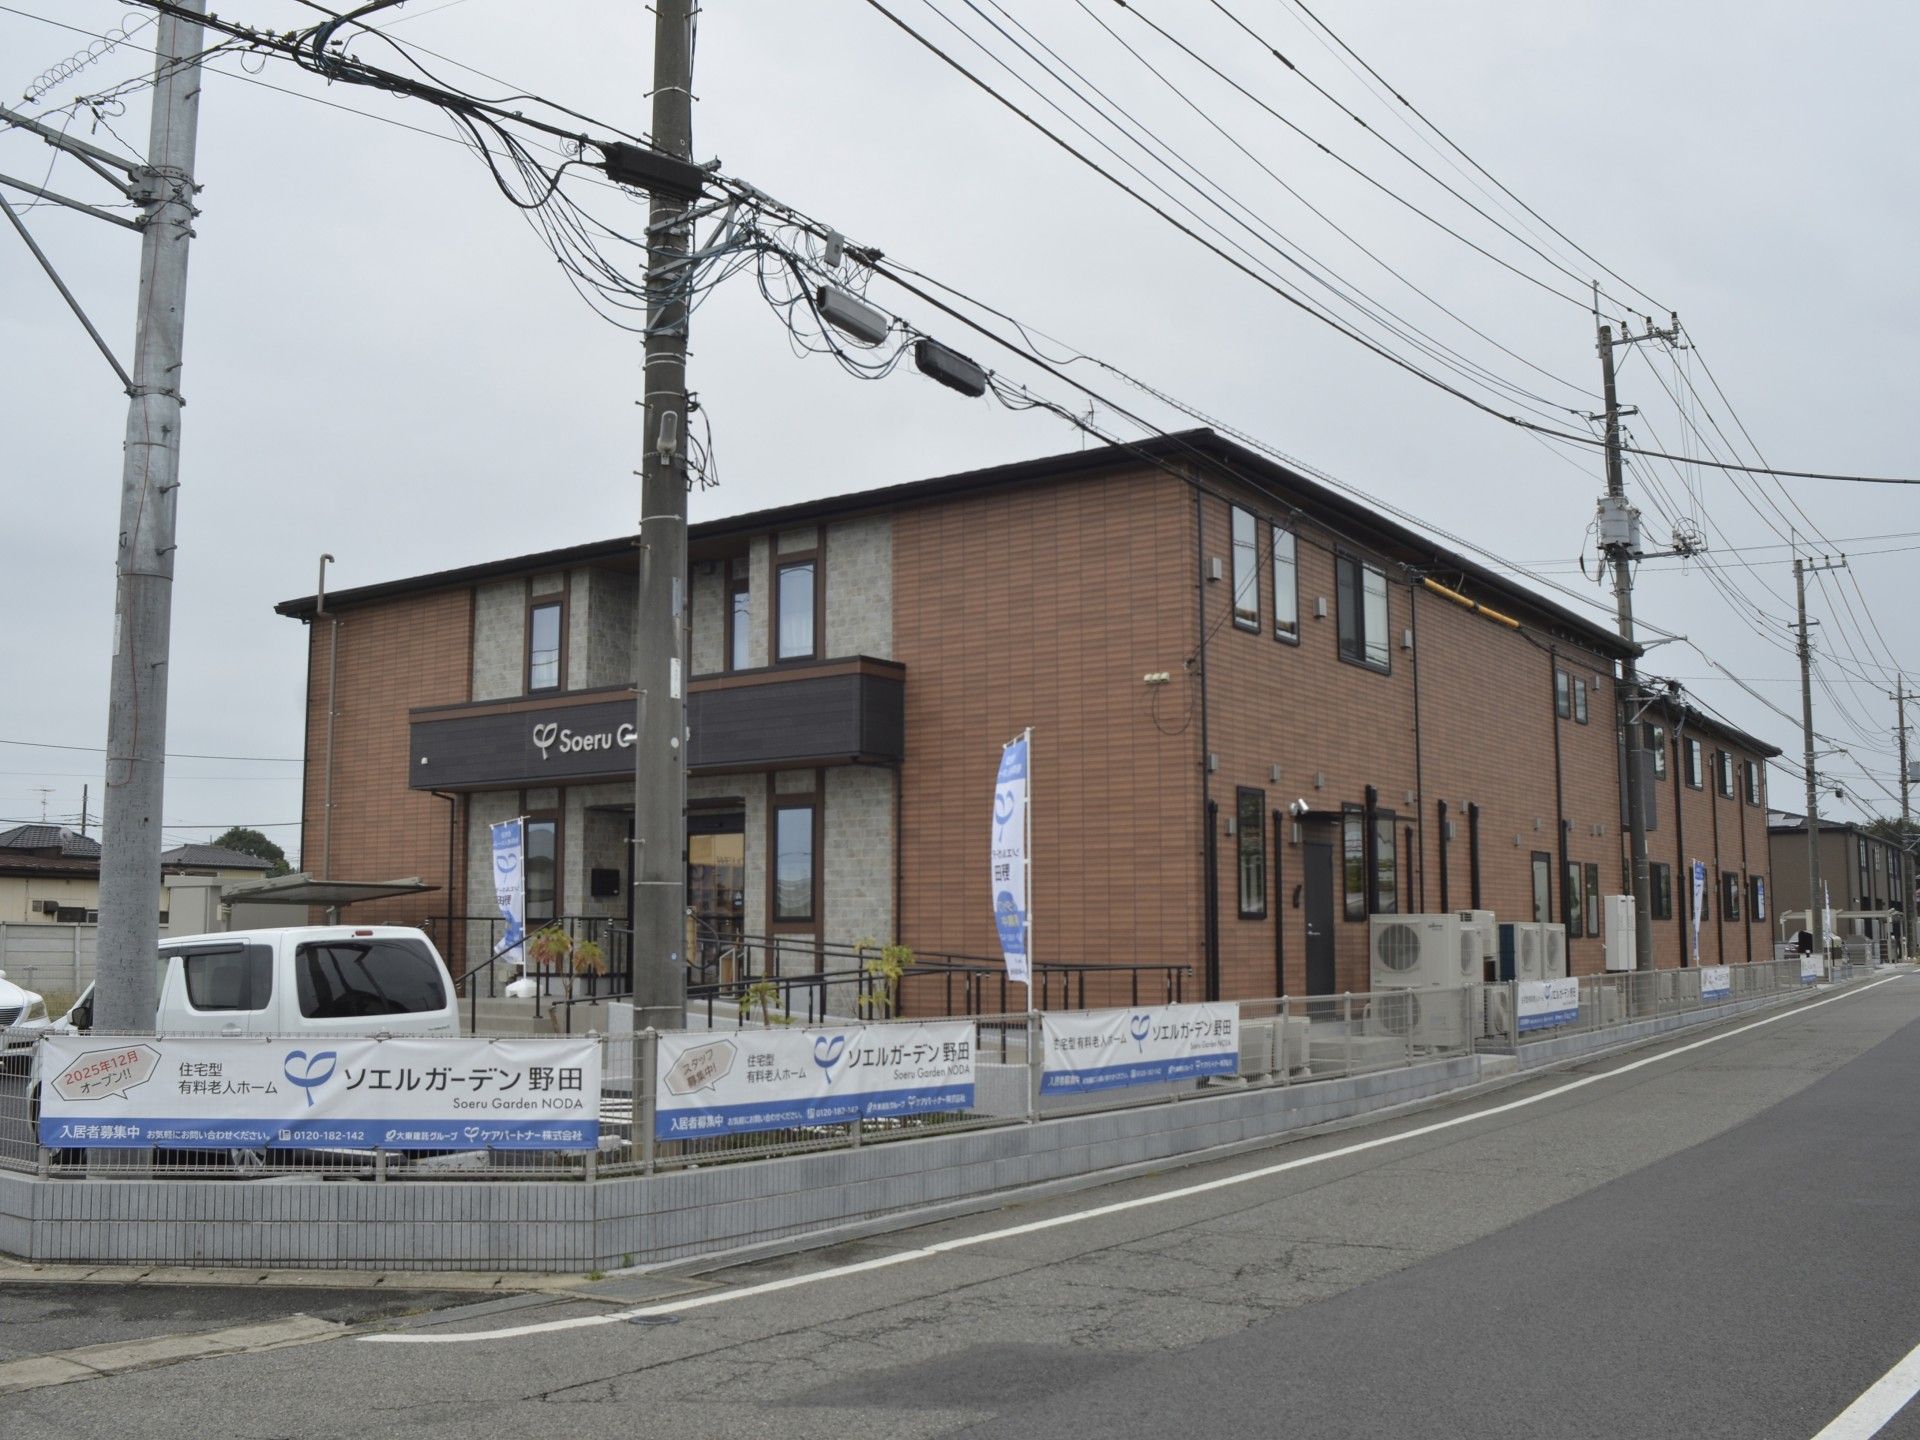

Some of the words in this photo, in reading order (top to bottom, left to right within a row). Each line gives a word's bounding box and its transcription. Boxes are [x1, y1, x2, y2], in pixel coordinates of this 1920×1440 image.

[559, 729, 611, 752] Soeru
[747, 1053, 775, 1068] 住宅型
[849, 1041, 969, 1068] ソエルガーデン野田
[64, 1051, 138, 1085] 2025年12月
[179, 1062, 222, 1077] 住宅型
[747, 1068, 807, 1083] 有料老人ホーム
[345, 1067, 583, 1091] ソエルガーデン野田
[179, 1080, 278, 1095] 有料老人ホーム
[453, 1098, 488, 1109] Soeru
[492, 1098, 537, 1109] Garden
[542, 1098, 583, 1109] NODA
[60, 1125, 140, 1139] 入居者募集中
[294, 1131, 364, 1140] 0120-182-142
[396, 1131, 458, 1140] 大東建託グループ
[481, 1130, 582, 1141] ケアパートナー株式会社
